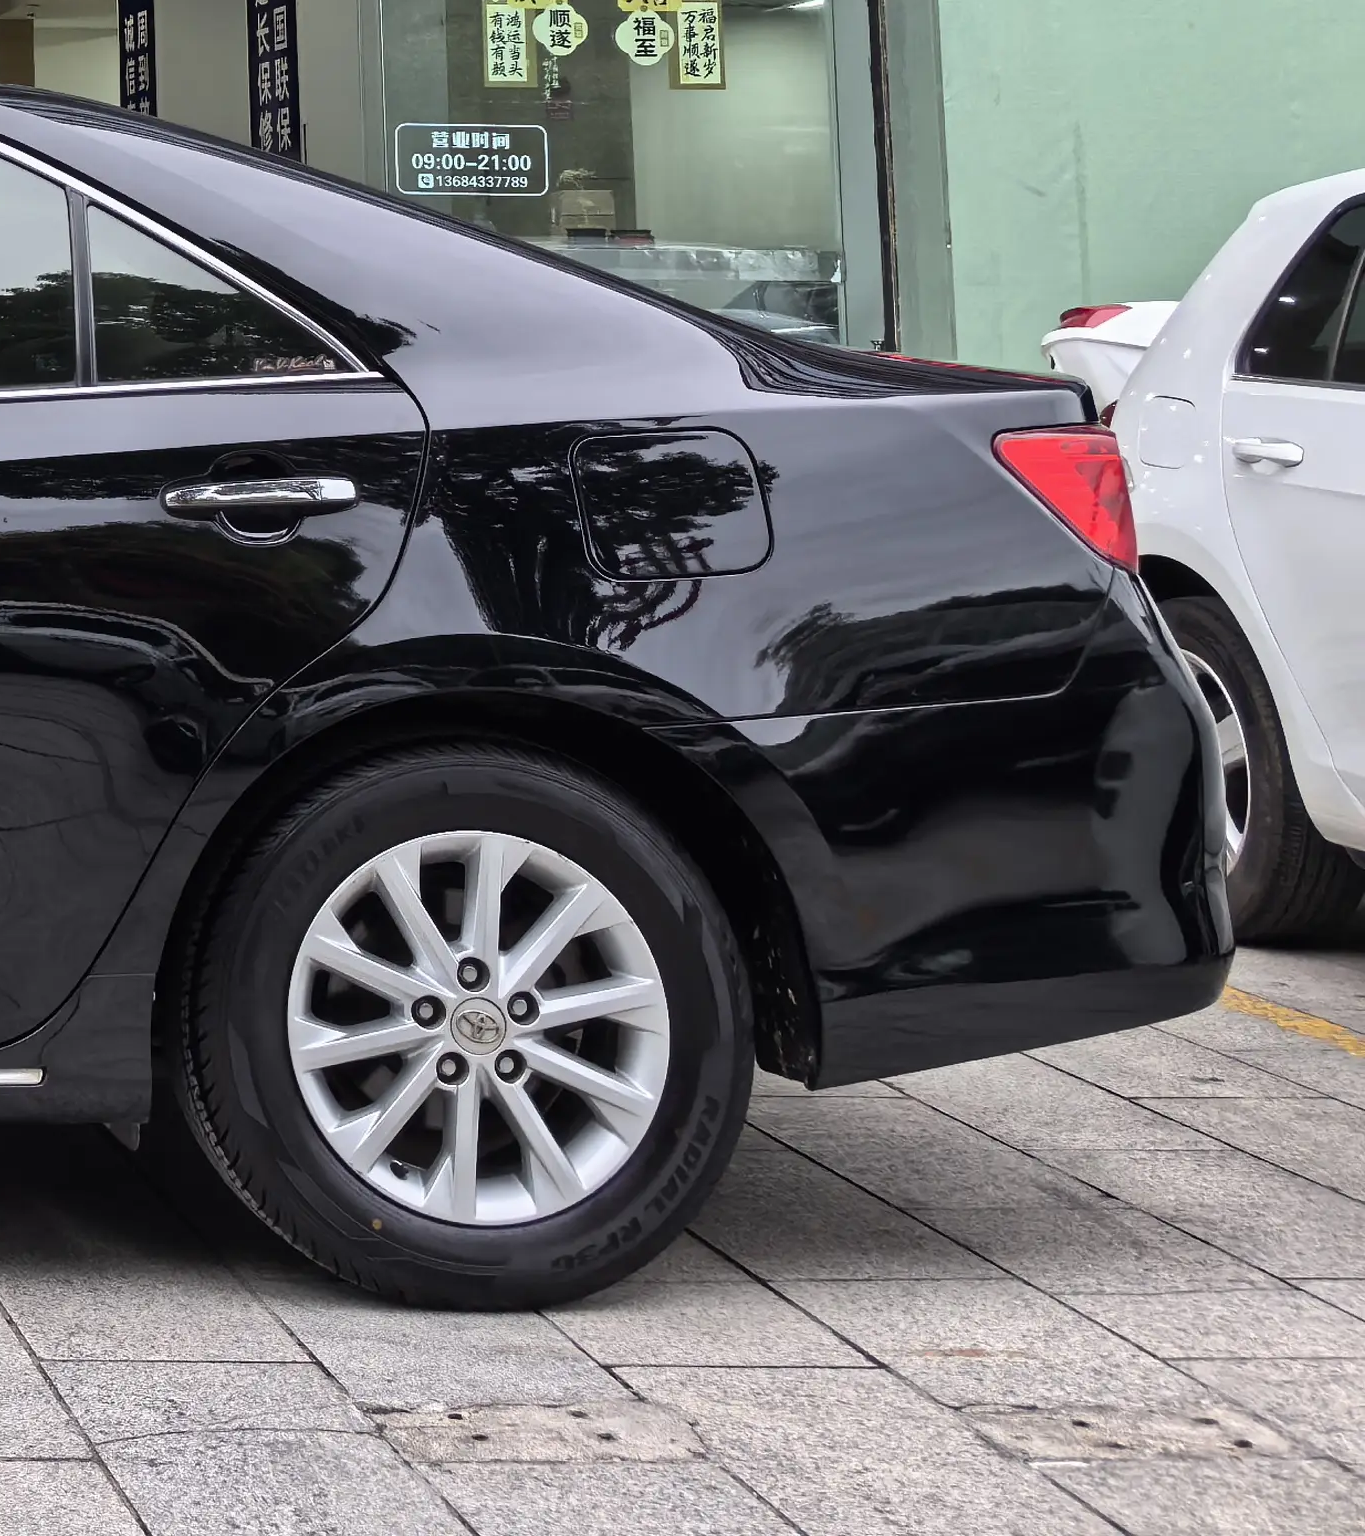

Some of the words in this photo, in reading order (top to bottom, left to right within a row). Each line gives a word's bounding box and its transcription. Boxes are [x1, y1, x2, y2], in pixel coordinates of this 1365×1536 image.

[431, 131, 510, 150] 营业时间
[435, 175, 528, 188] 13684337789
